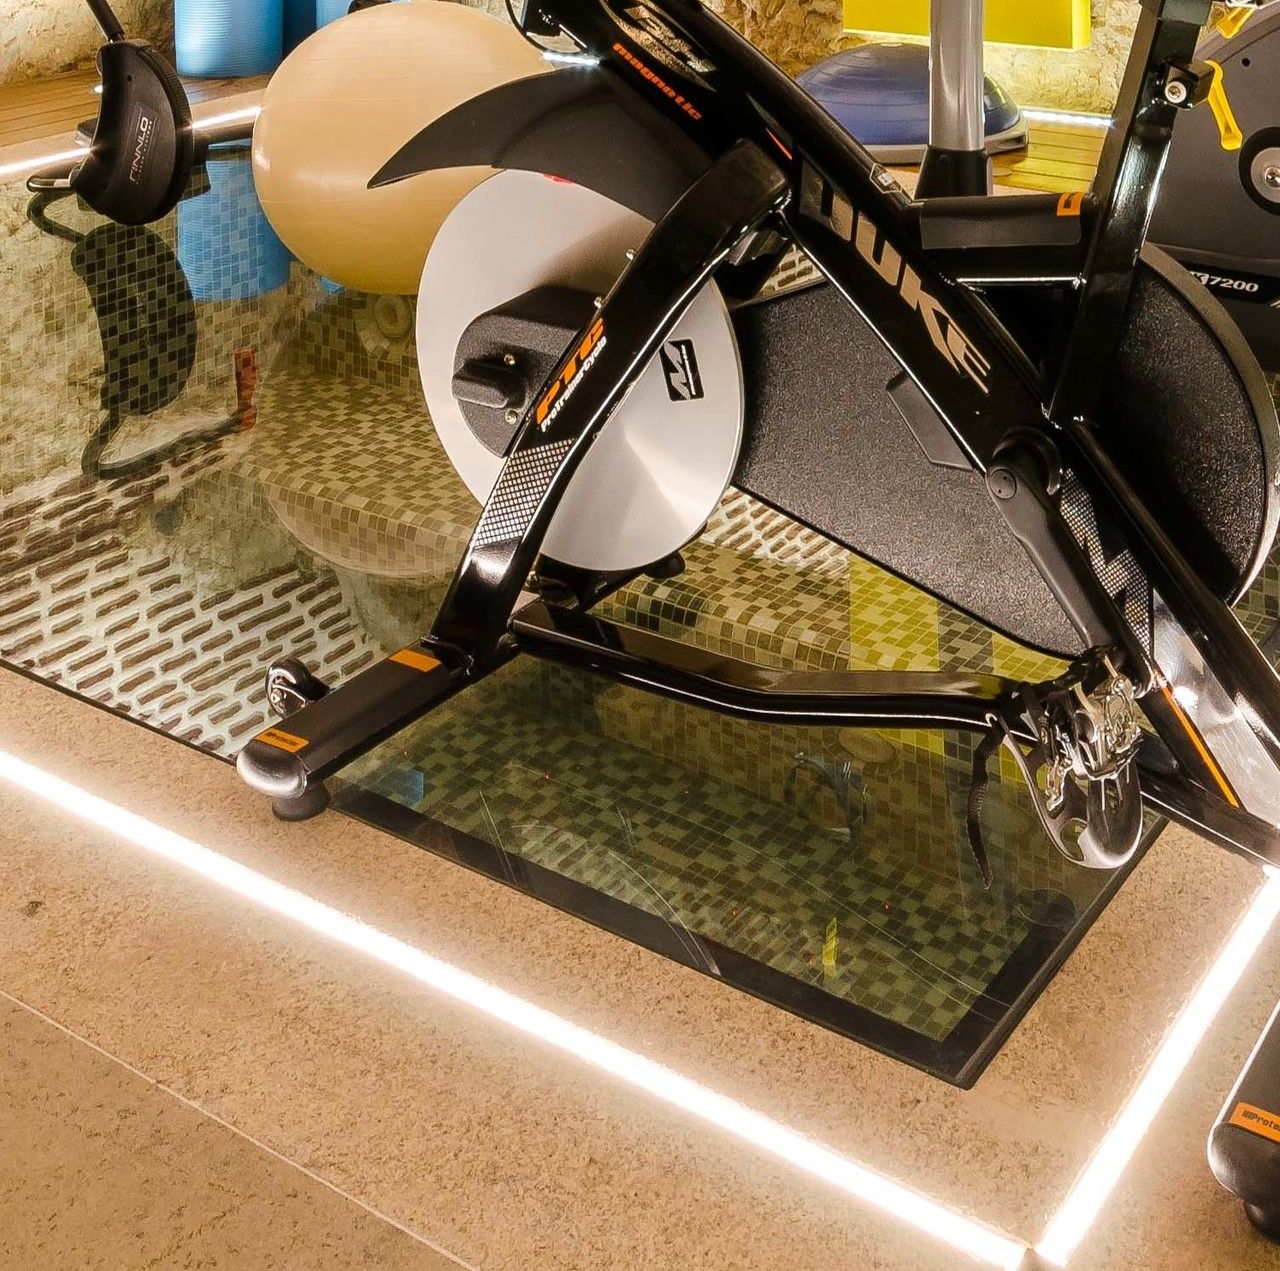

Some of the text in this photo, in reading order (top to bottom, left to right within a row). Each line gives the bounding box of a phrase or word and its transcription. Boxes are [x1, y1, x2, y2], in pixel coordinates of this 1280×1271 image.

[612, 42, 702, 121] magnetic
[799, 156, 992, 395] DUKE
[536, 317, 605, 425] PTC
